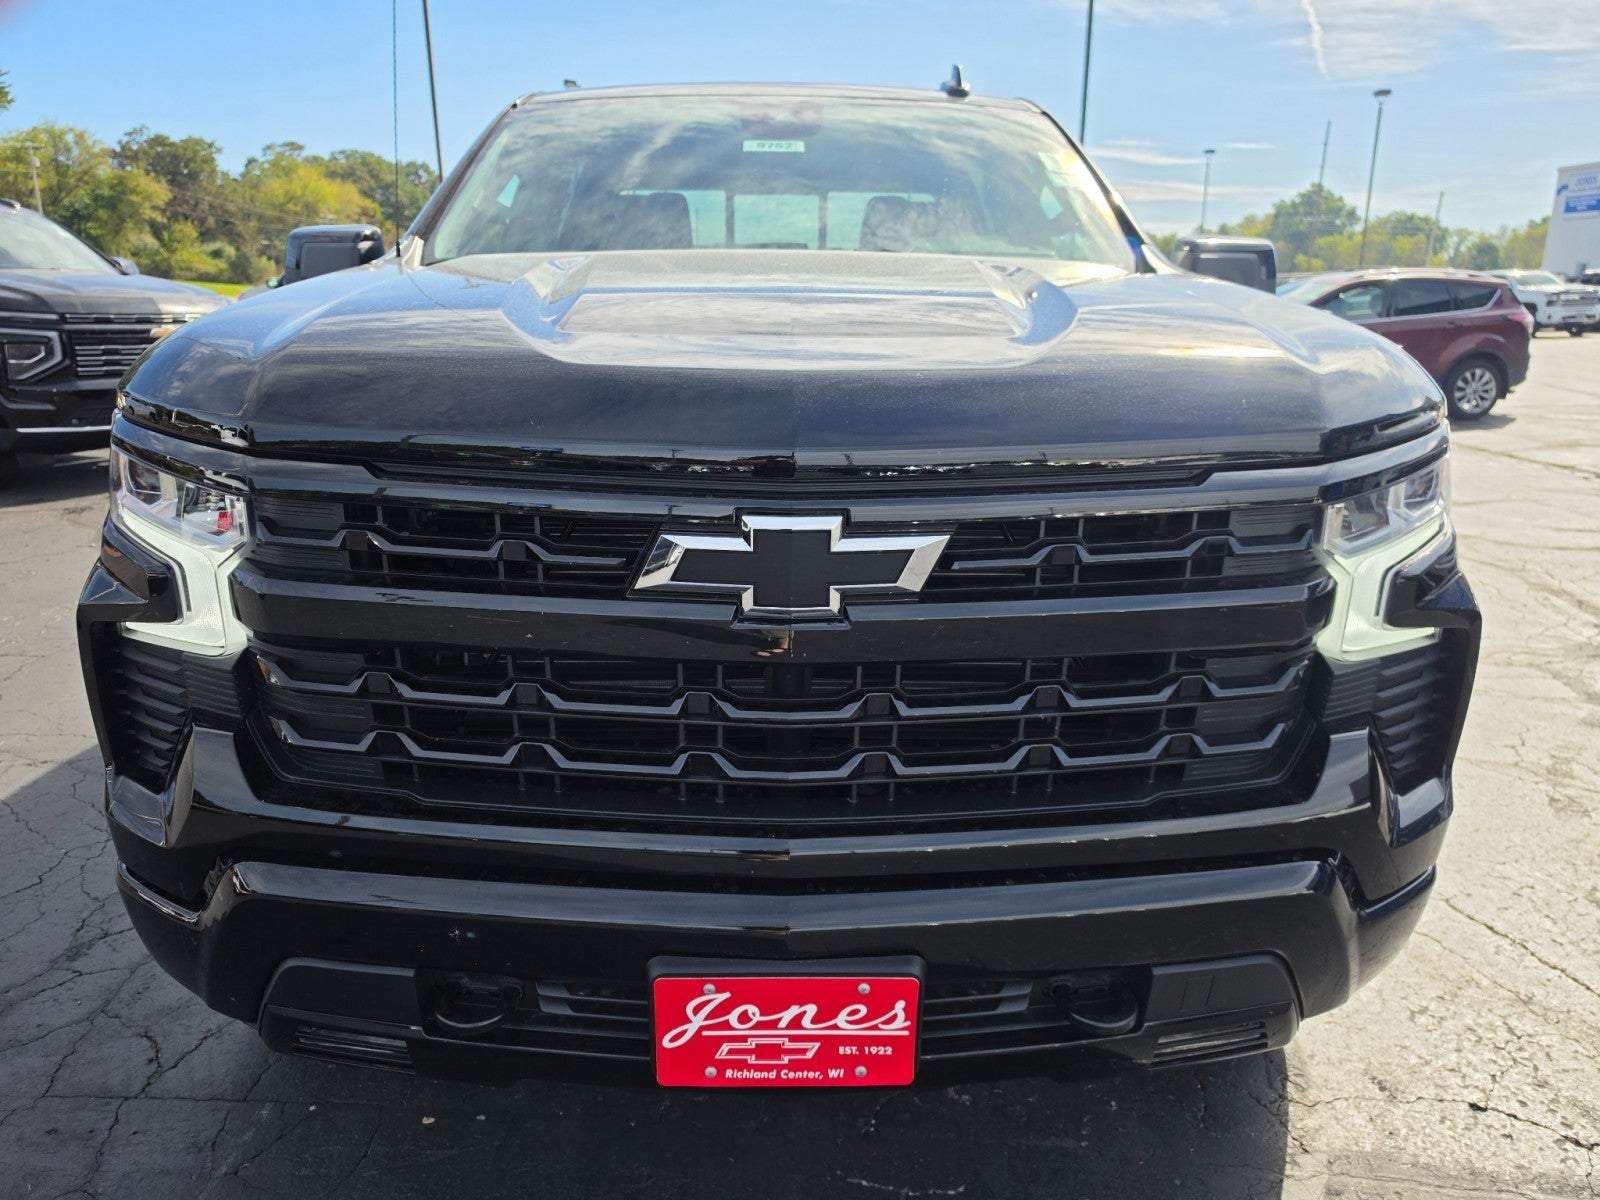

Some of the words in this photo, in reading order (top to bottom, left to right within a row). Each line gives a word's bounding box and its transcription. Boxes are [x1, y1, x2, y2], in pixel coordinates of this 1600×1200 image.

[662, 992, 911, 1049] Jones
[838, 1046, 859, 1055] EST.
[864, 1046, 893, 1055] 1922
[725, 1069, 776, 1079] Richland
[780, 1069, 824, 1080] Center,
[828, 1069, 844, 1078] WI
